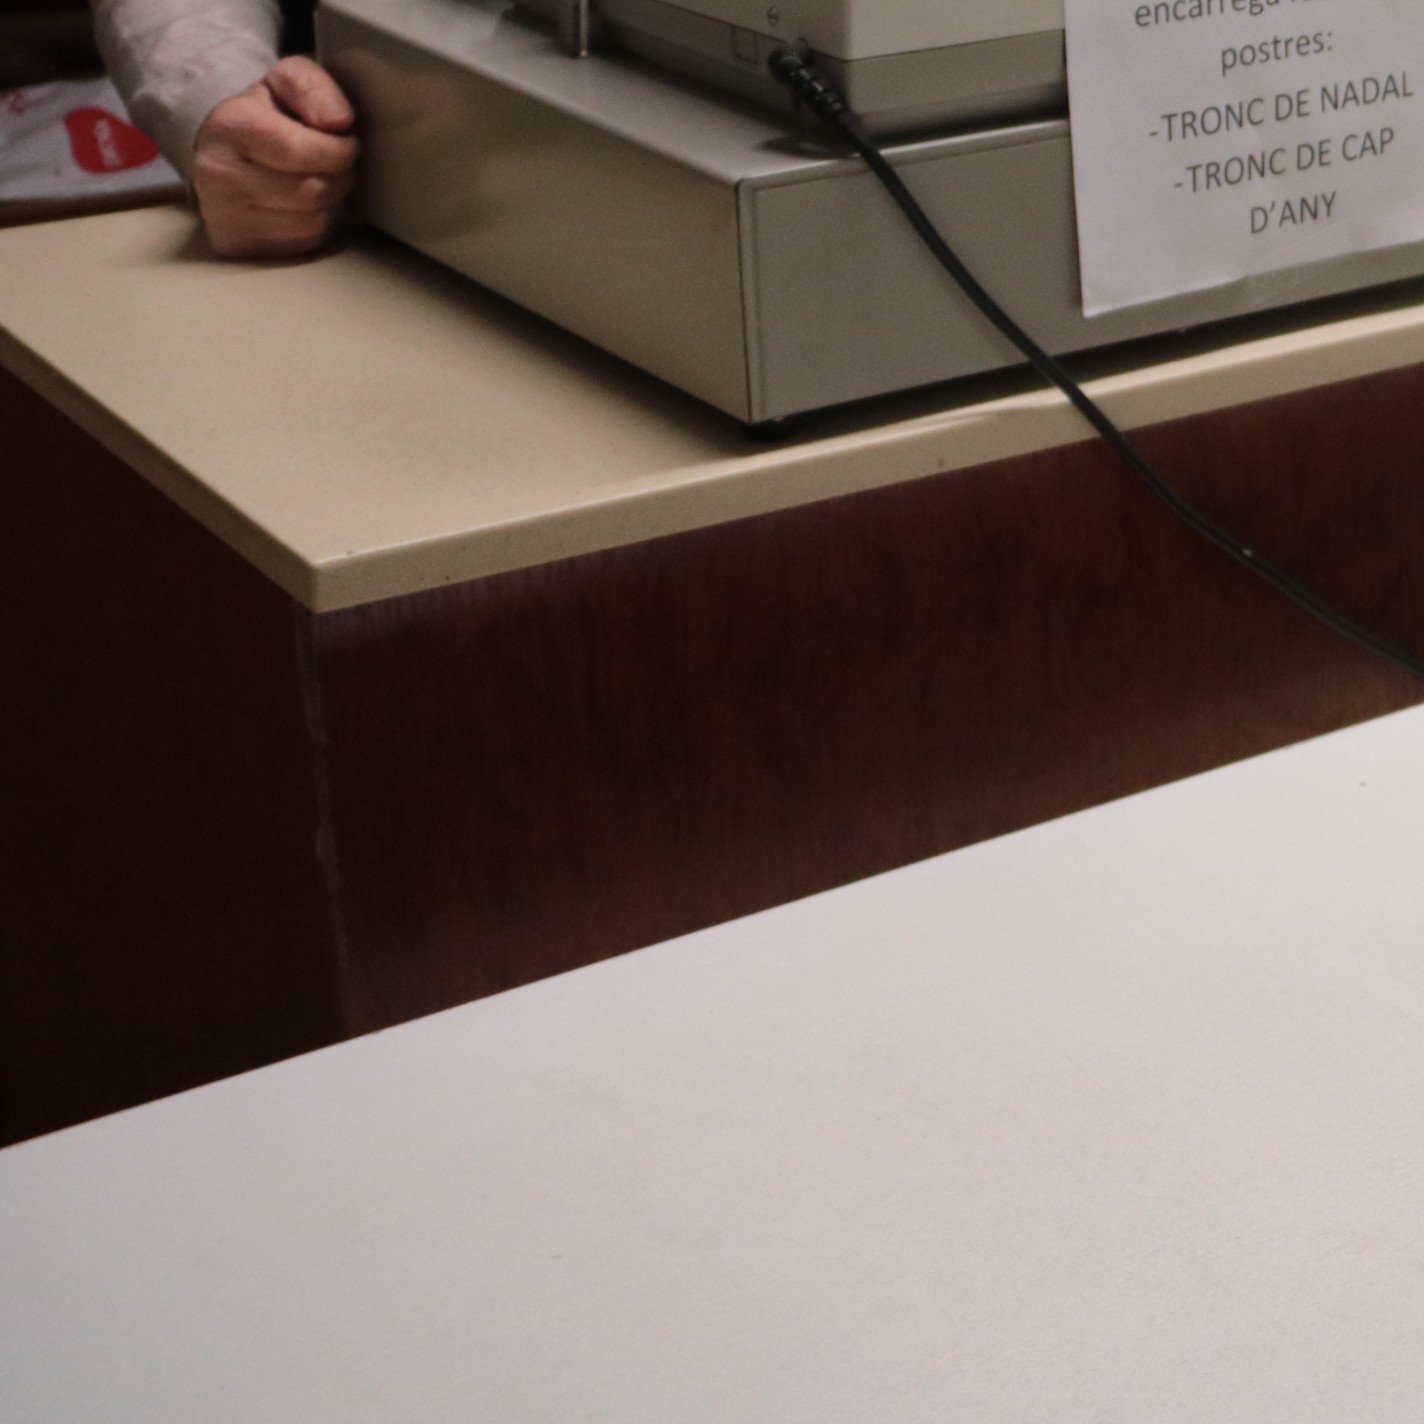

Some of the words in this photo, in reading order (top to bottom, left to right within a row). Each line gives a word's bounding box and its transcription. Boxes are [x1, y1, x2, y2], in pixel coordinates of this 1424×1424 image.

[1220, 30, 1333, 76] postres:
[1149, 98, 1264, 141] -TRONC
[1275, 89, 1310, 121] DE
[1320, 71, 1414, 113] NADAL
[1174, 148, 1286, 192] -TRONC
[1296, 139, 1331, 170] DE
[1342, 127, 1394, 161] CAP
[1250, 191, 1337, 235] D'ANY
